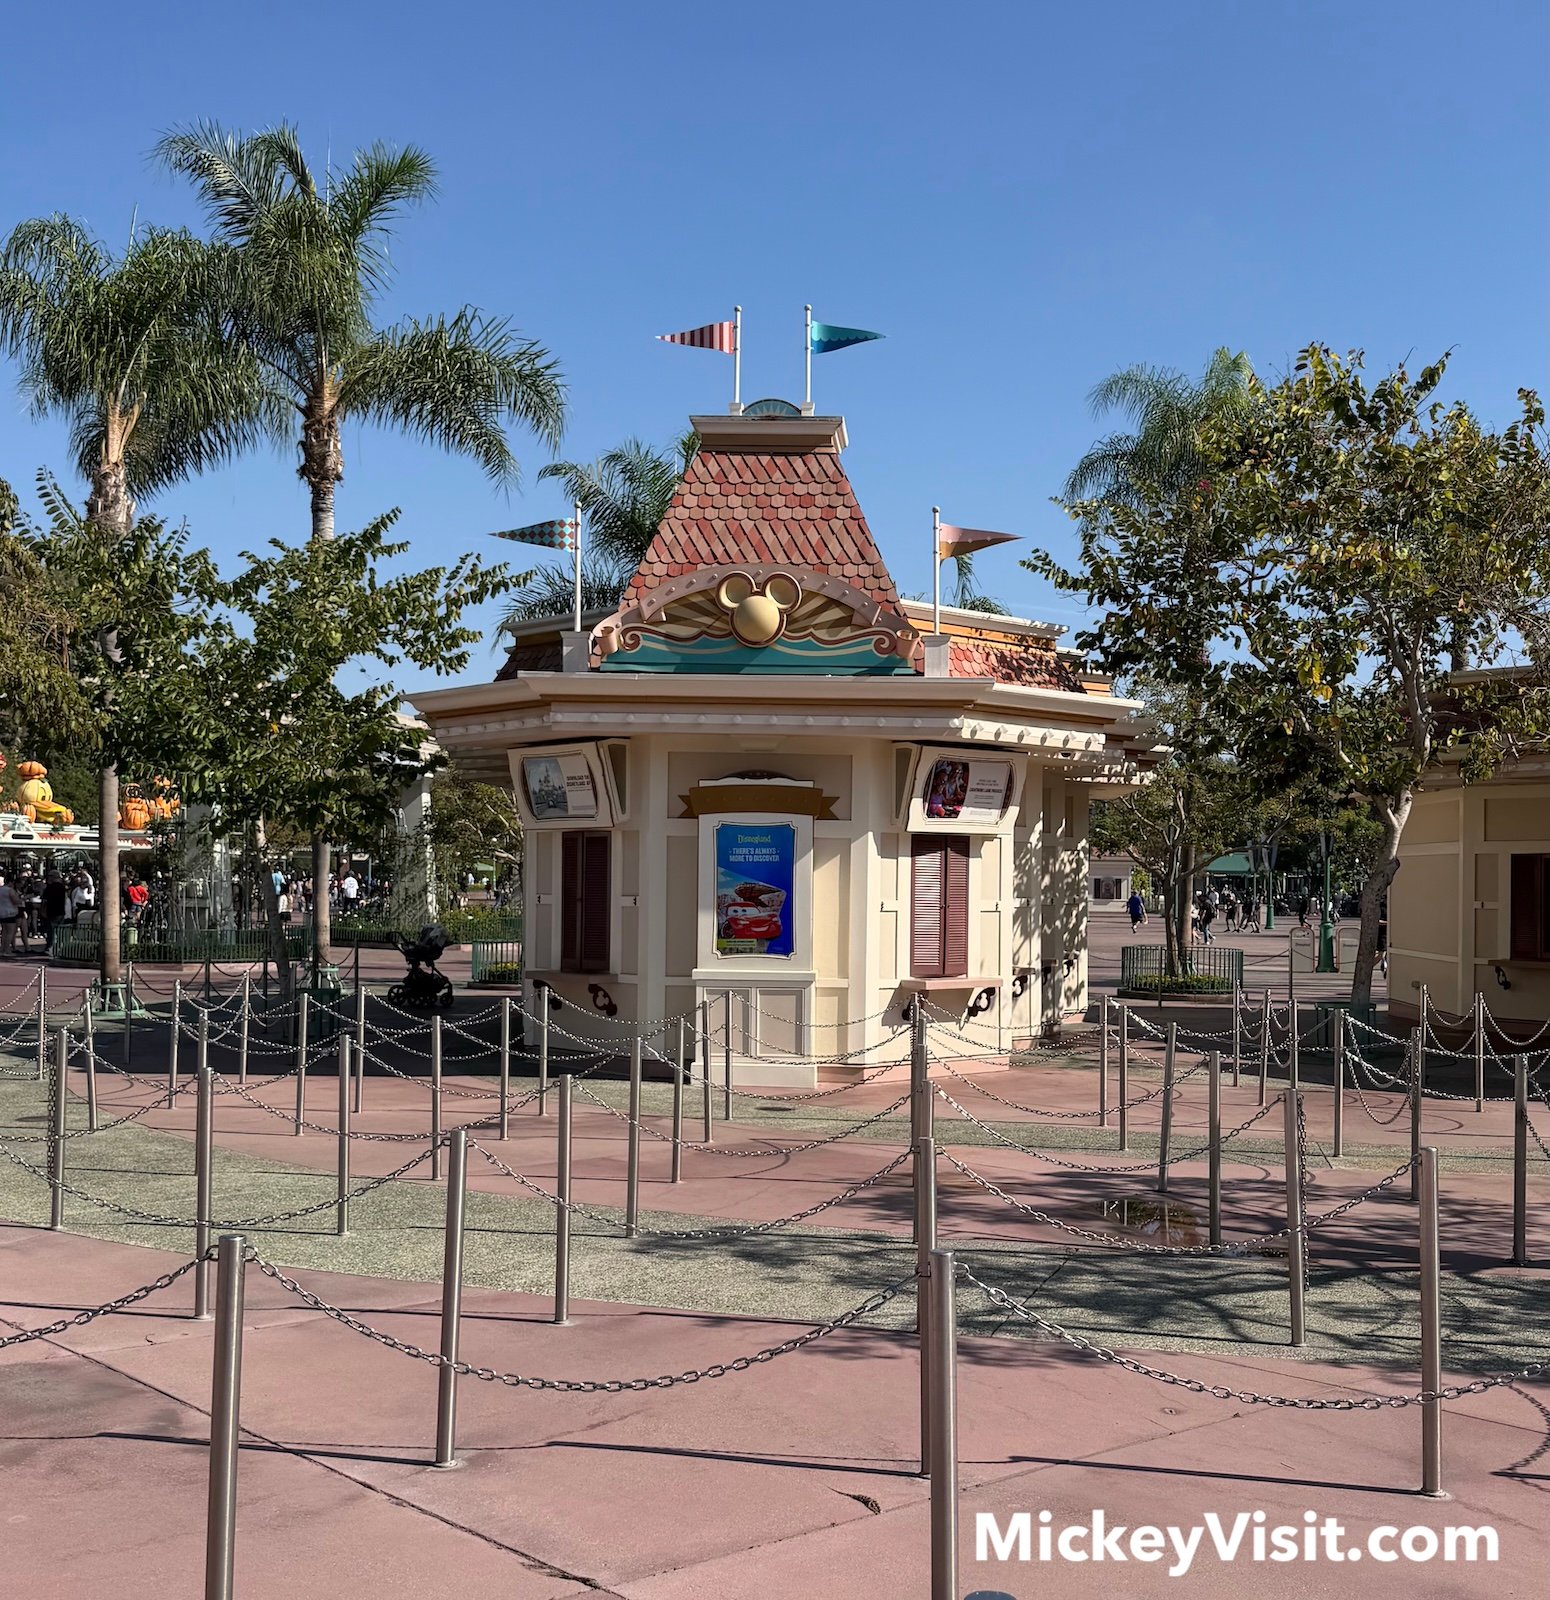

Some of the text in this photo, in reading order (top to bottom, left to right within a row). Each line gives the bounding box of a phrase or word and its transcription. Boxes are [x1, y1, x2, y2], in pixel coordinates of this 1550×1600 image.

[737, 834, 771, 844] Disneyland
[732, 847, 777, 855] THERE'S ALWAYS
